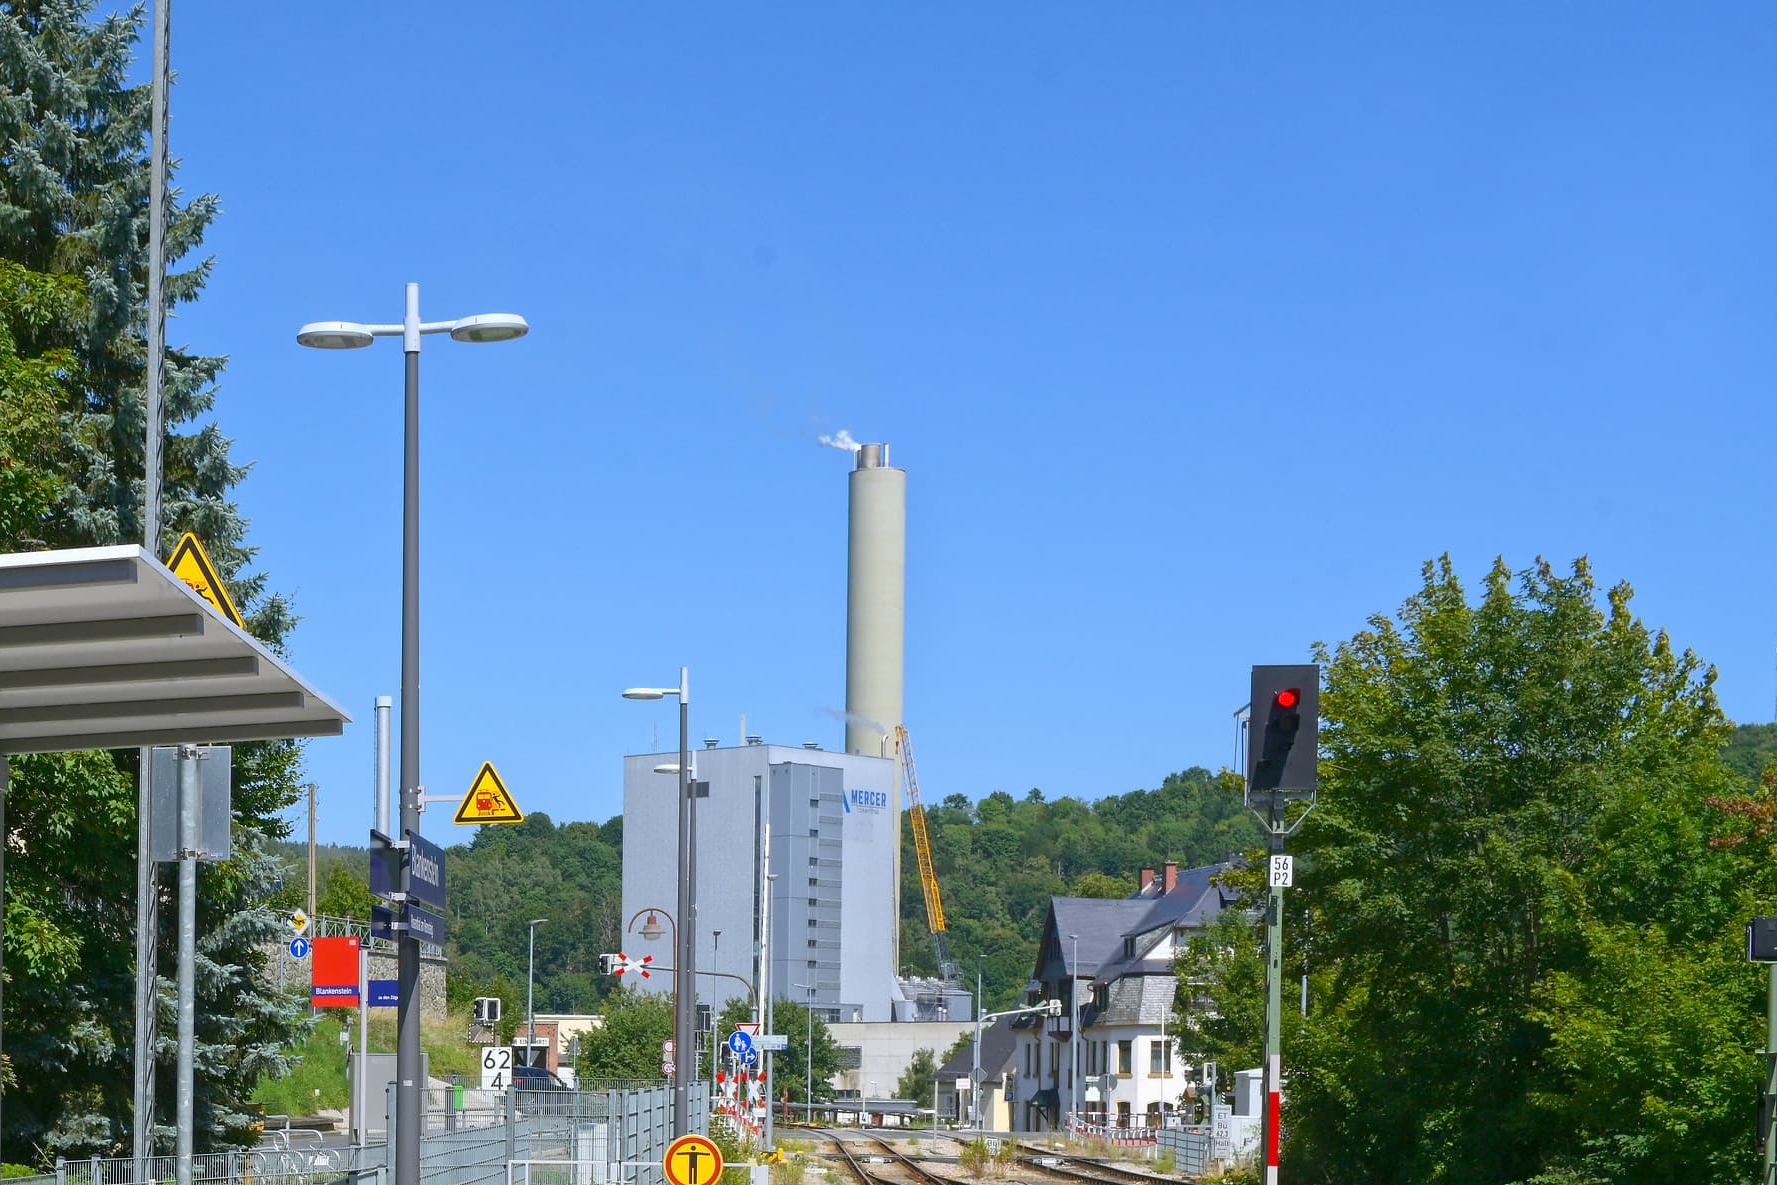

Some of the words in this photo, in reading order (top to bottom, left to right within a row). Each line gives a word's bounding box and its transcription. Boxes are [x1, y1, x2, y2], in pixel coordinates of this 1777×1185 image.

[851, 789, 886, 807] MERCER
[411, 843, 439, 887] Blankenstein
[1274, 857, 1288, 870] 56
[1273, 872, 1288, 885] P2
[315, 987, 352, 995] Blankenstein
[483, 1050, 510, 1069] 62
[490, 1071, 503, 1090] 4
